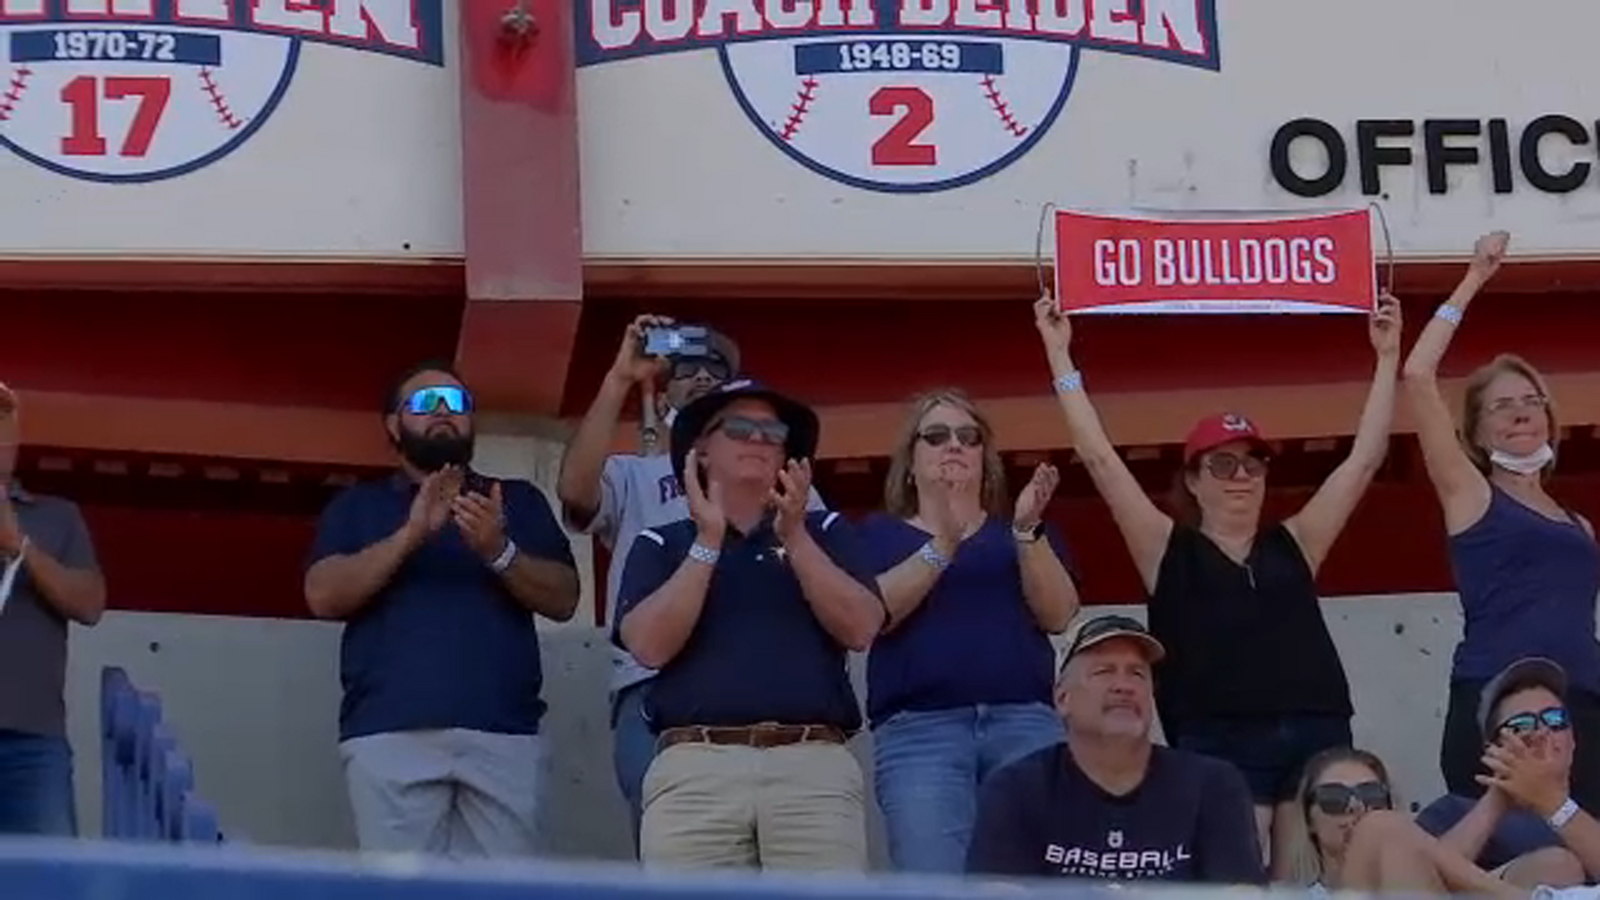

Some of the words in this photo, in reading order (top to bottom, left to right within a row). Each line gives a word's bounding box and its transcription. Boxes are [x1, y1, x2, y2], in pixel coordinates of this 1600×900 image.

[54, 31, 176, 60] 1970-72
[839, 42, 960, 70] 1948-69
[60, 76, 171, 156] 17
[869, 87, 936, 165] 2
[1269, 114, 1600, 197] OFFIC
[1094, 239, 1141, 286] GO
[1154, 237, 1336, 285] BULLDOGS
[1044, 844, 1191, 871] BASEBALL
